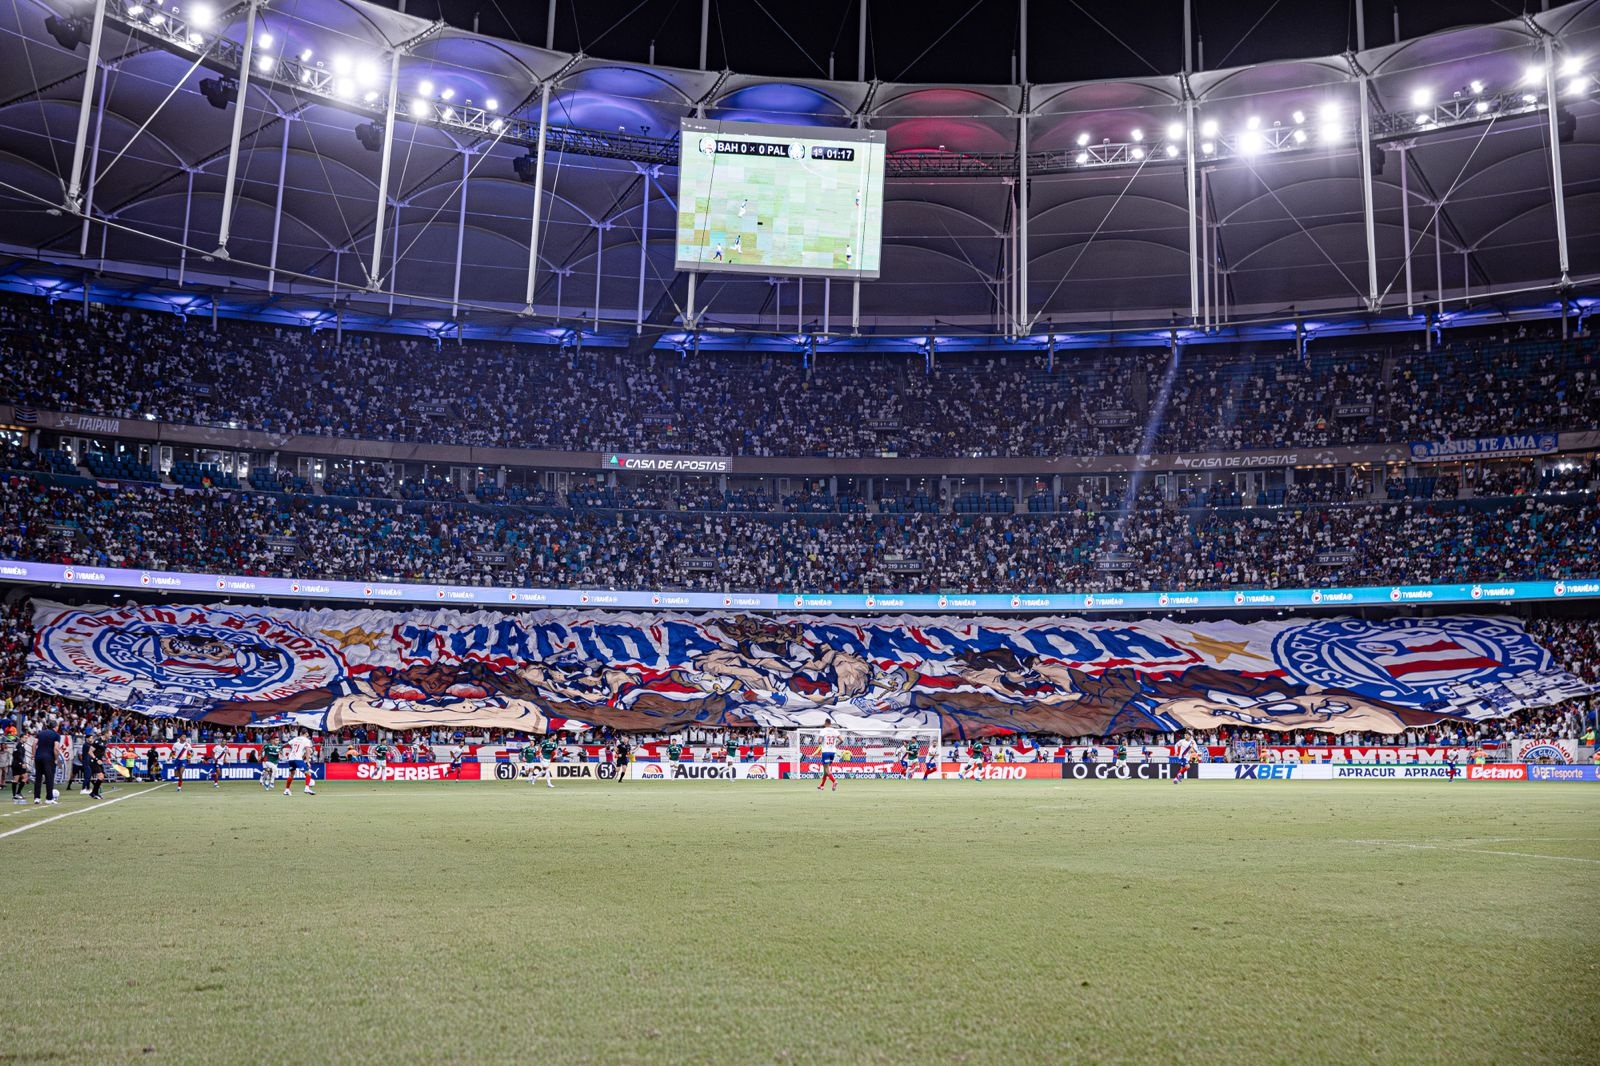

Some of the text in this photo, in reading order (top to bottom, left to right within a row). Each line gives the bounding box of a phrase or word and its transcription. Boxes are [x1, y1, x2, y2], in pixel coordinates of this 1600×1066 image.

[718, 141, 739, 153] BAH
[741, 142, 747, 153] 0
[758, 144, 765, 154] 0
[767, 145, 786, 156] PAL
[826, 150, 852, 160] 01:17
[77, 416, 120, 433] ITAIPAVA
[1430, 435, 1537, 455] JESUS TE AMA
[625, 459, 726, 471] CASA DE APOSTAS
[1191, 454, 1298, 468] CASA DE APOSTAS
[1291, 618, 1530, 689] ESPORTE CLUBE BAHIA
[826, 735, 835, 746] 33
[167, 767, 200, 780] PMA
[221, 767, 255, 780] PUMA
[356, 763, 451, 780] SUPERBET
[500, 764, 513, 778] 51
[557, 765, 592, 778] IDEIA
[641, 772, 664, 780] Aurora
[1234, 764, 1298, 780] 1XBET
[1338, 767, 1396, 777] APRACUR
[1470, 766, 1524, 779] Betano
